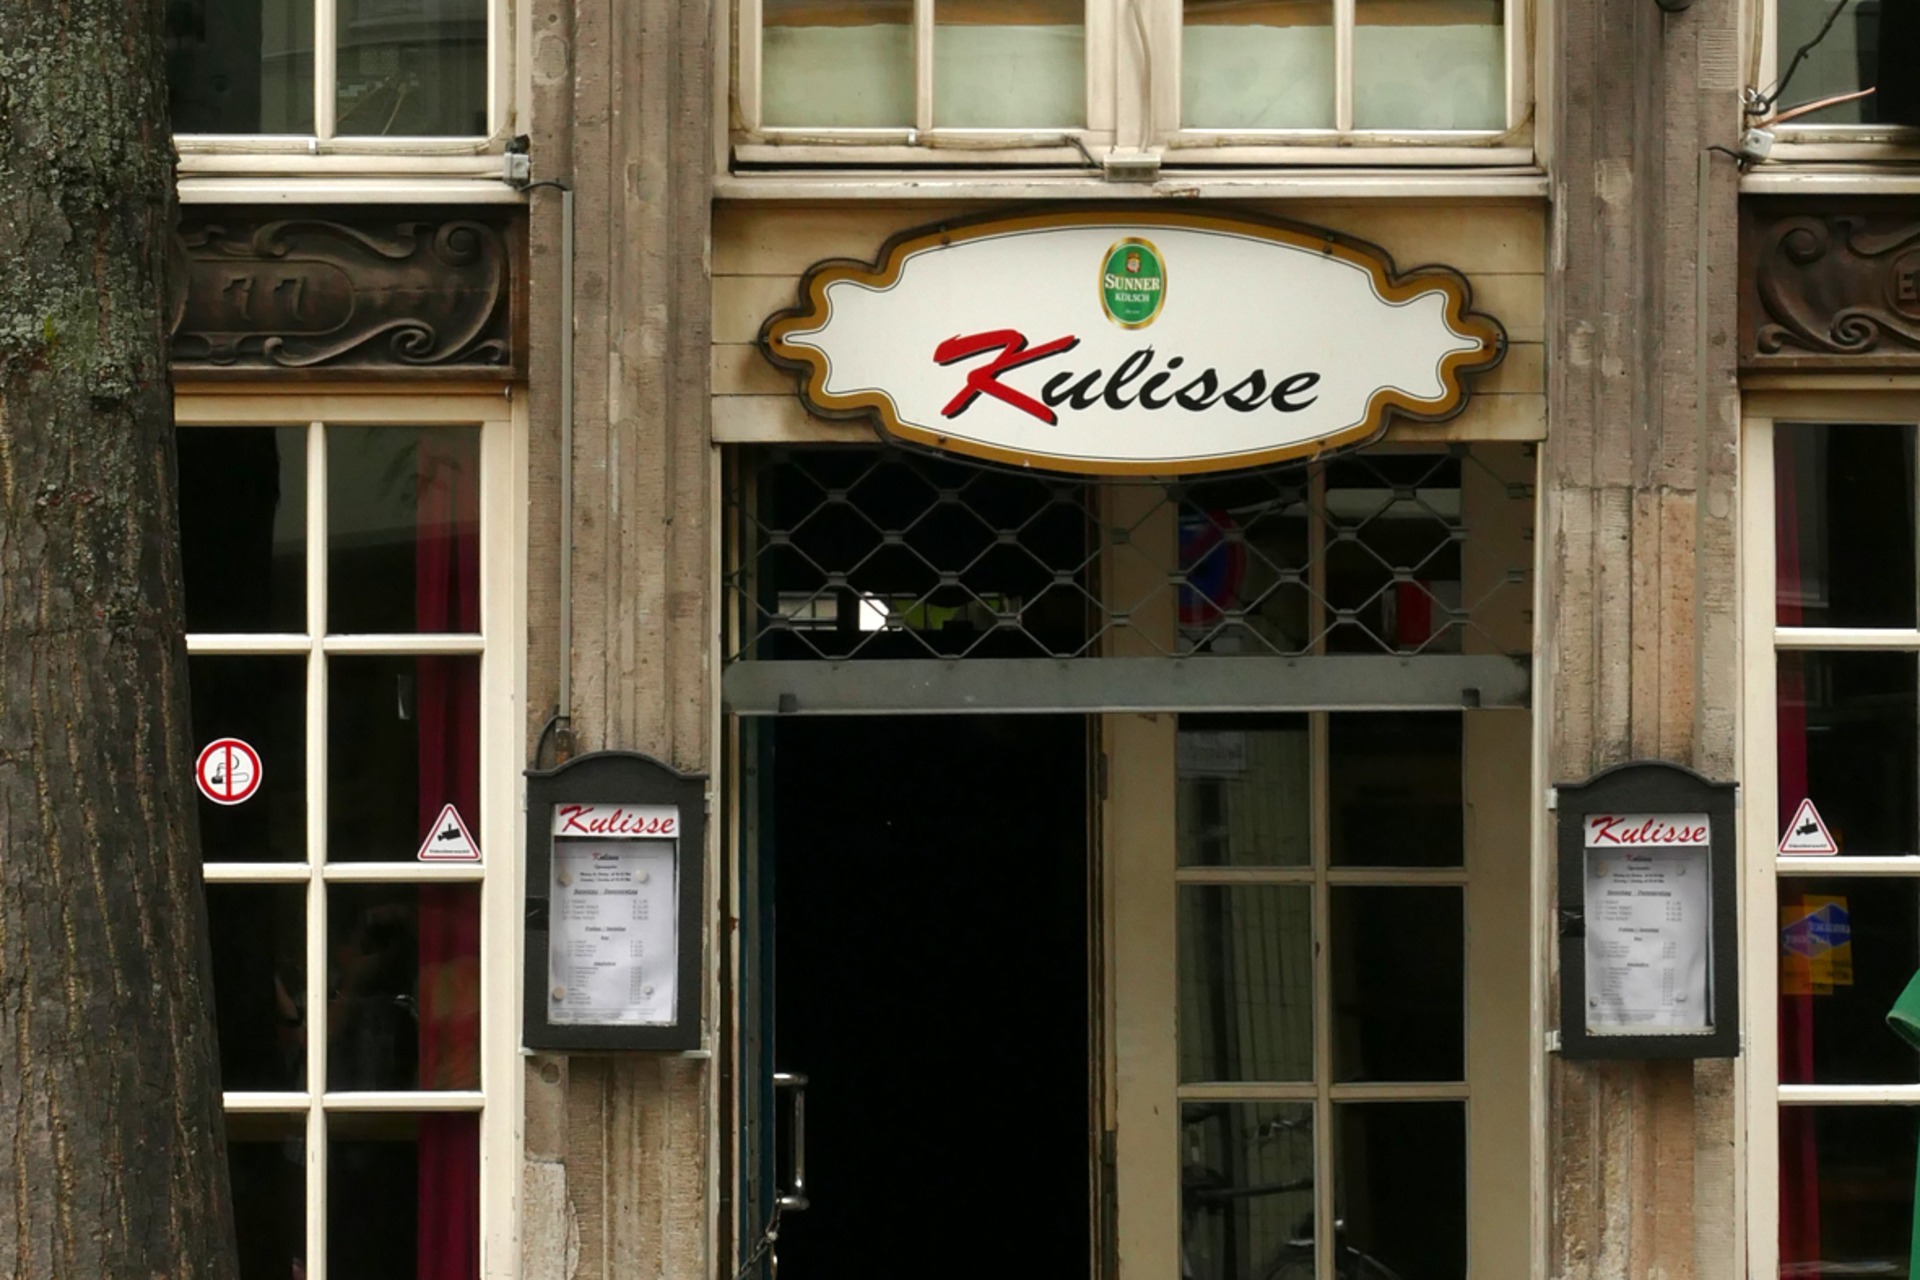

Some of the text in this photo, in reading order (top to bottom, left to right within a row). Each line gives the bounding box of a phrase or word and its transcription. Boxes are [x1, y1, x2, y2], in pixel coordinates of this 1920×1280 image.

[933, 328, 1321, 426] Kulisse
[560, 804, 676, 834] Kulisse
[1591, 816, 1707, 844] Kulisse
